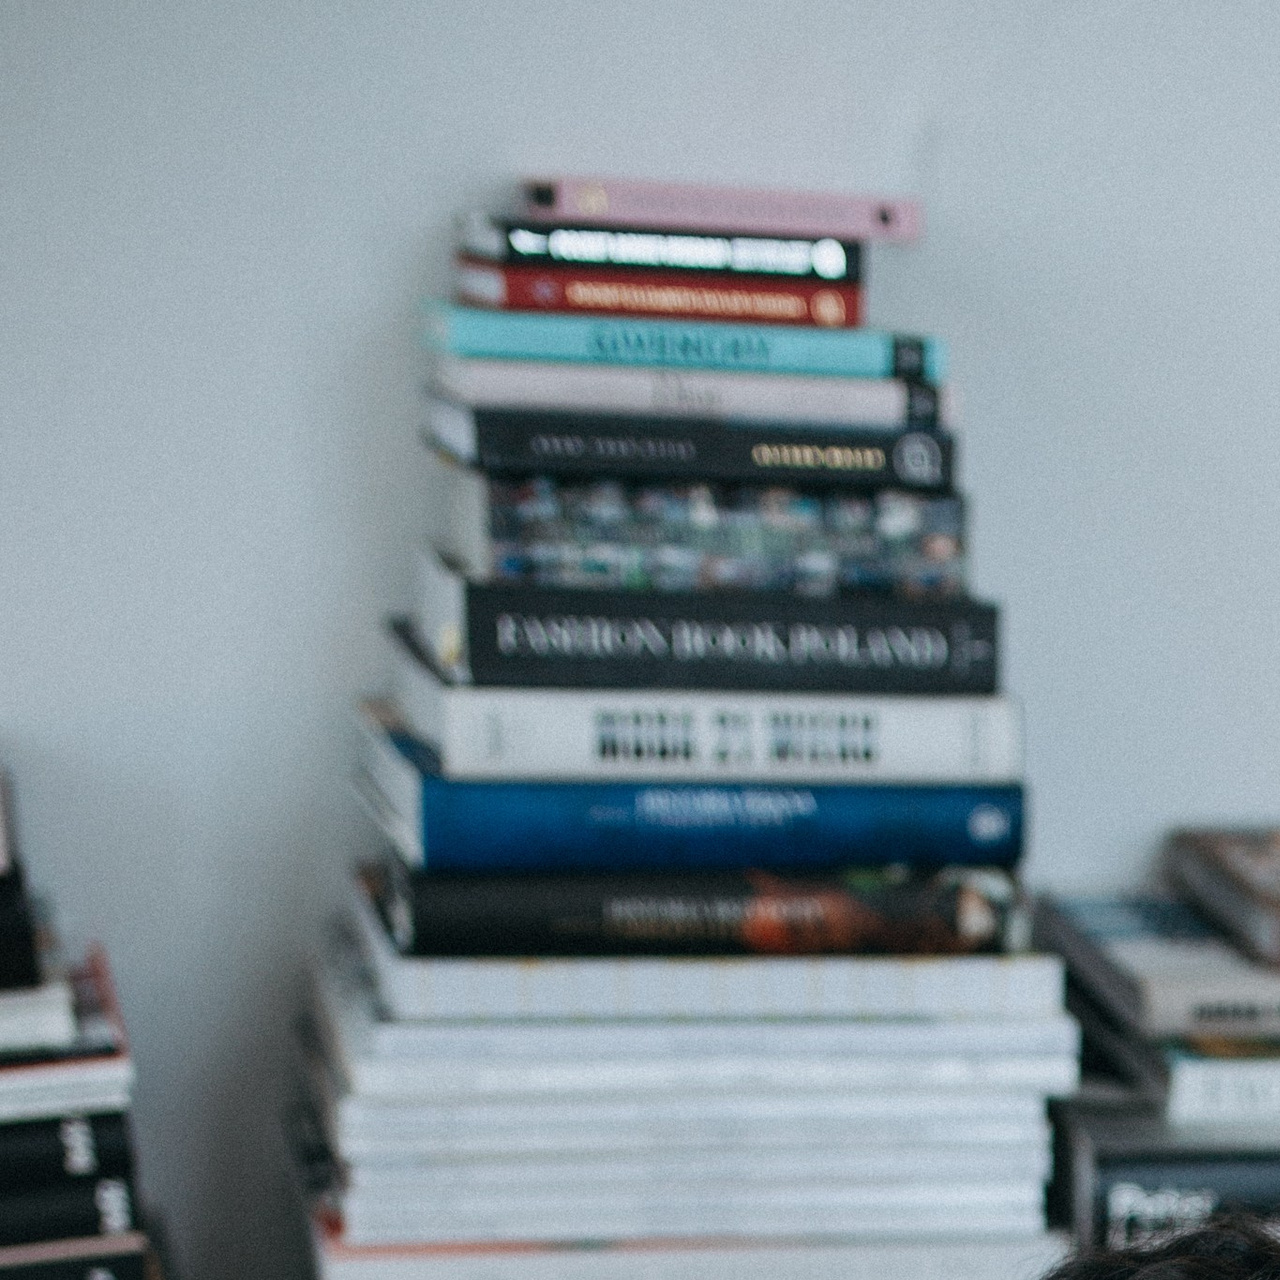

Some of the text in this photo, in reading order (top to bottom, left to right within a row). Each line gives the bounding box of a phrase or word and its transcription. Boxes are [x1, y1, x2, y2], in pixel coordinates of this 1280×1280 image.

[497, 613, 666, 656] FASHION
[674, 619, 788, 661] BOOK
[791, 624, 947, 667] POLAND
